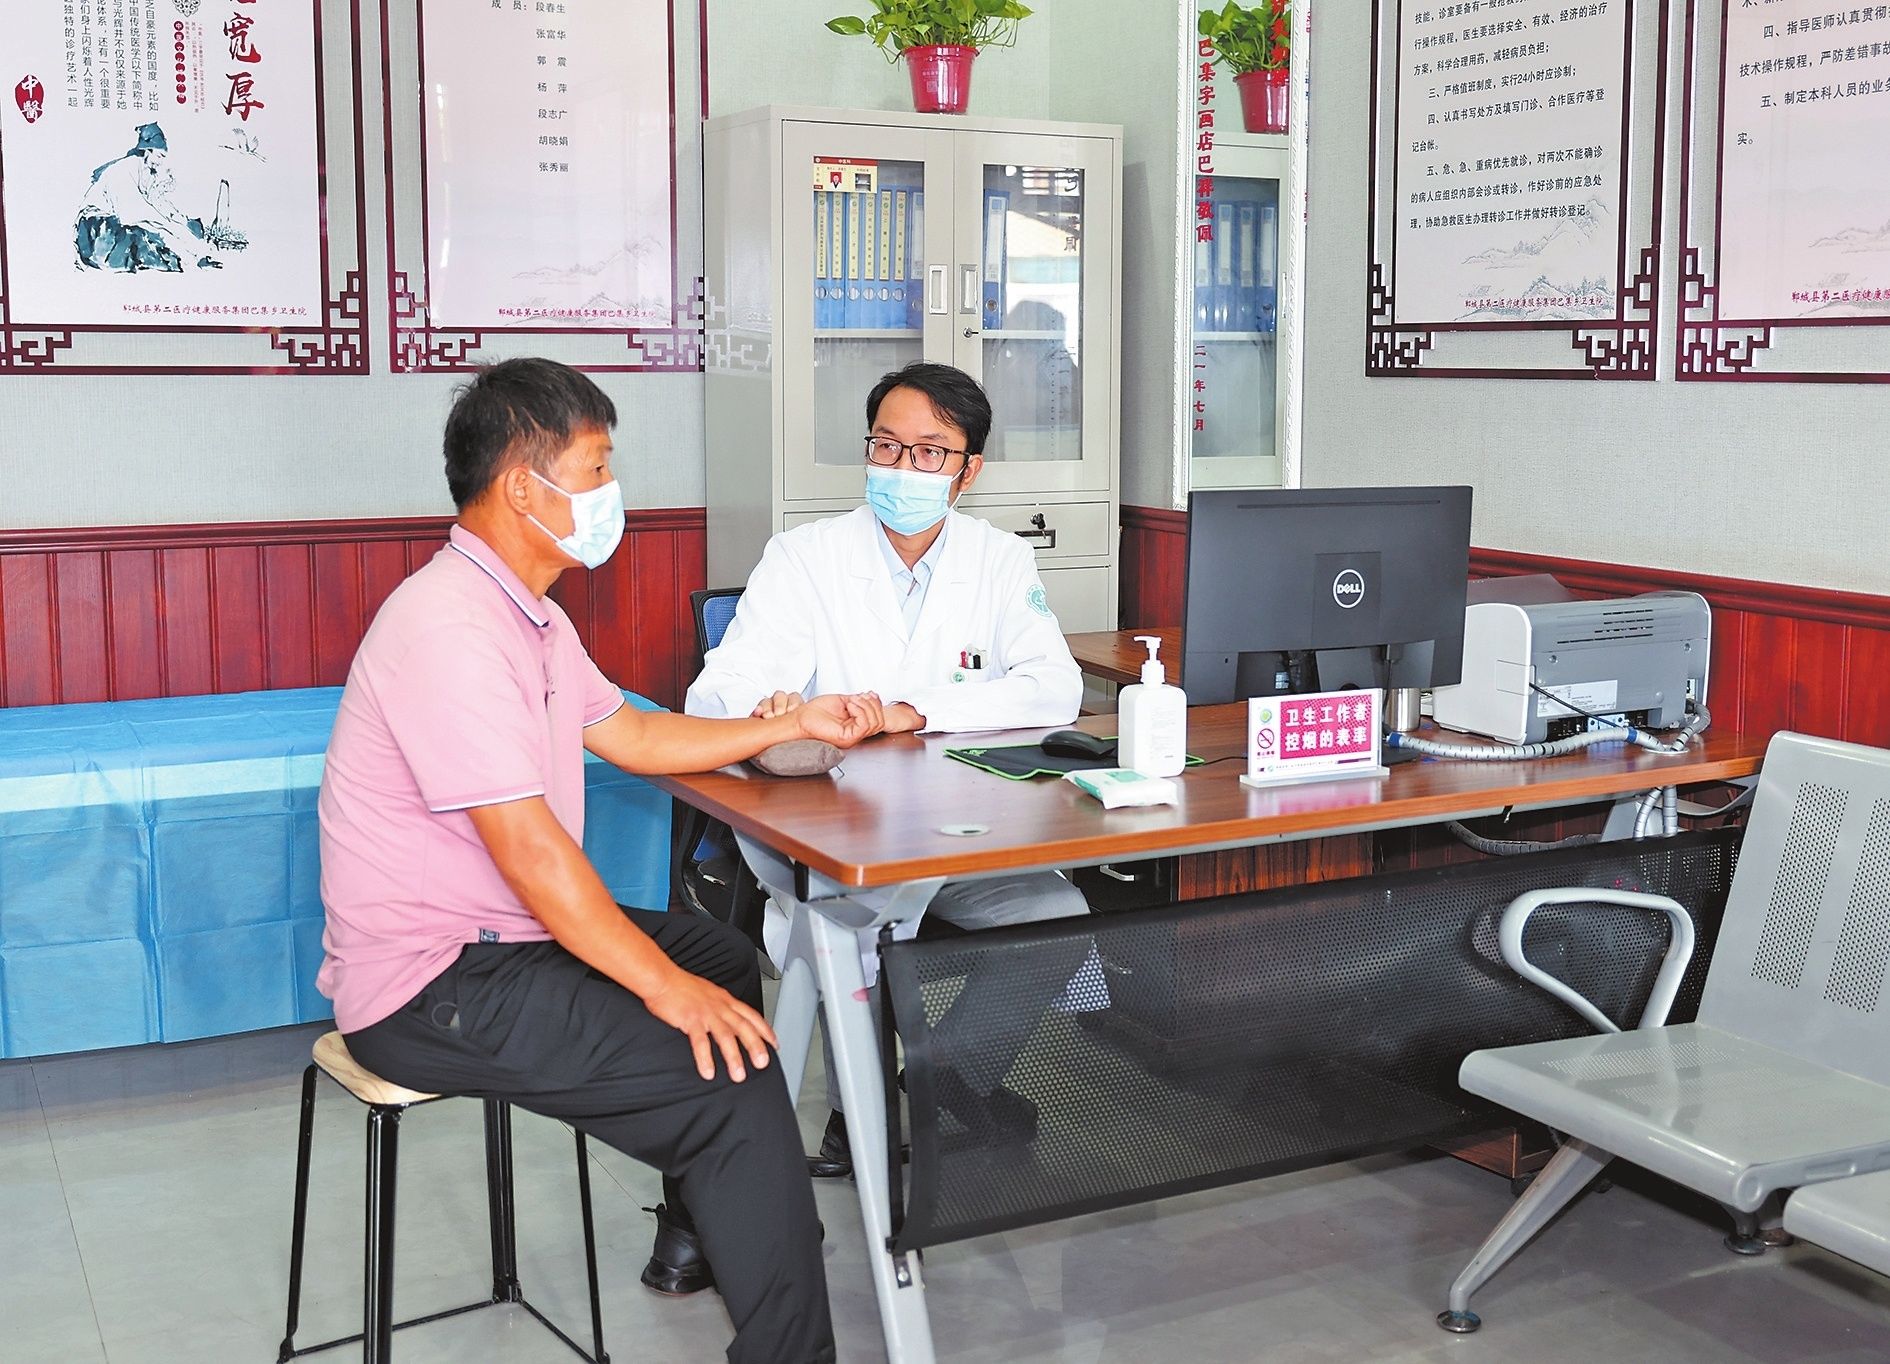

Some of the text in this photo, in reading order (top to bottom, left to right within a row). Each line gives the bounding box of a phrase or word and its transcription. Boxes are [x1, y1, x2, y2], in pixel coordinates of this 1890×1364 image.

[1763, 5, 1890, 39] 四、指导医师认真贯彻
[536, 28, 567, 40] 张富华
[64, 0, 78, 107] 独特的诊疗艺术一起
[221, 0, 265, 122] 宽厚
[538, 108, 568, 120] 段志广
[538, 135, 569, 147] 胡晓娟
[1737, 132, 1754, 146] 实。
[539, 162, 569, 173] 张秀丽
[1336, 583, 1361, 595] DELL
[1285, 702, 1367, 727] 卫生工作者
[1284, 726, 1368, 752] 控烟的表率
